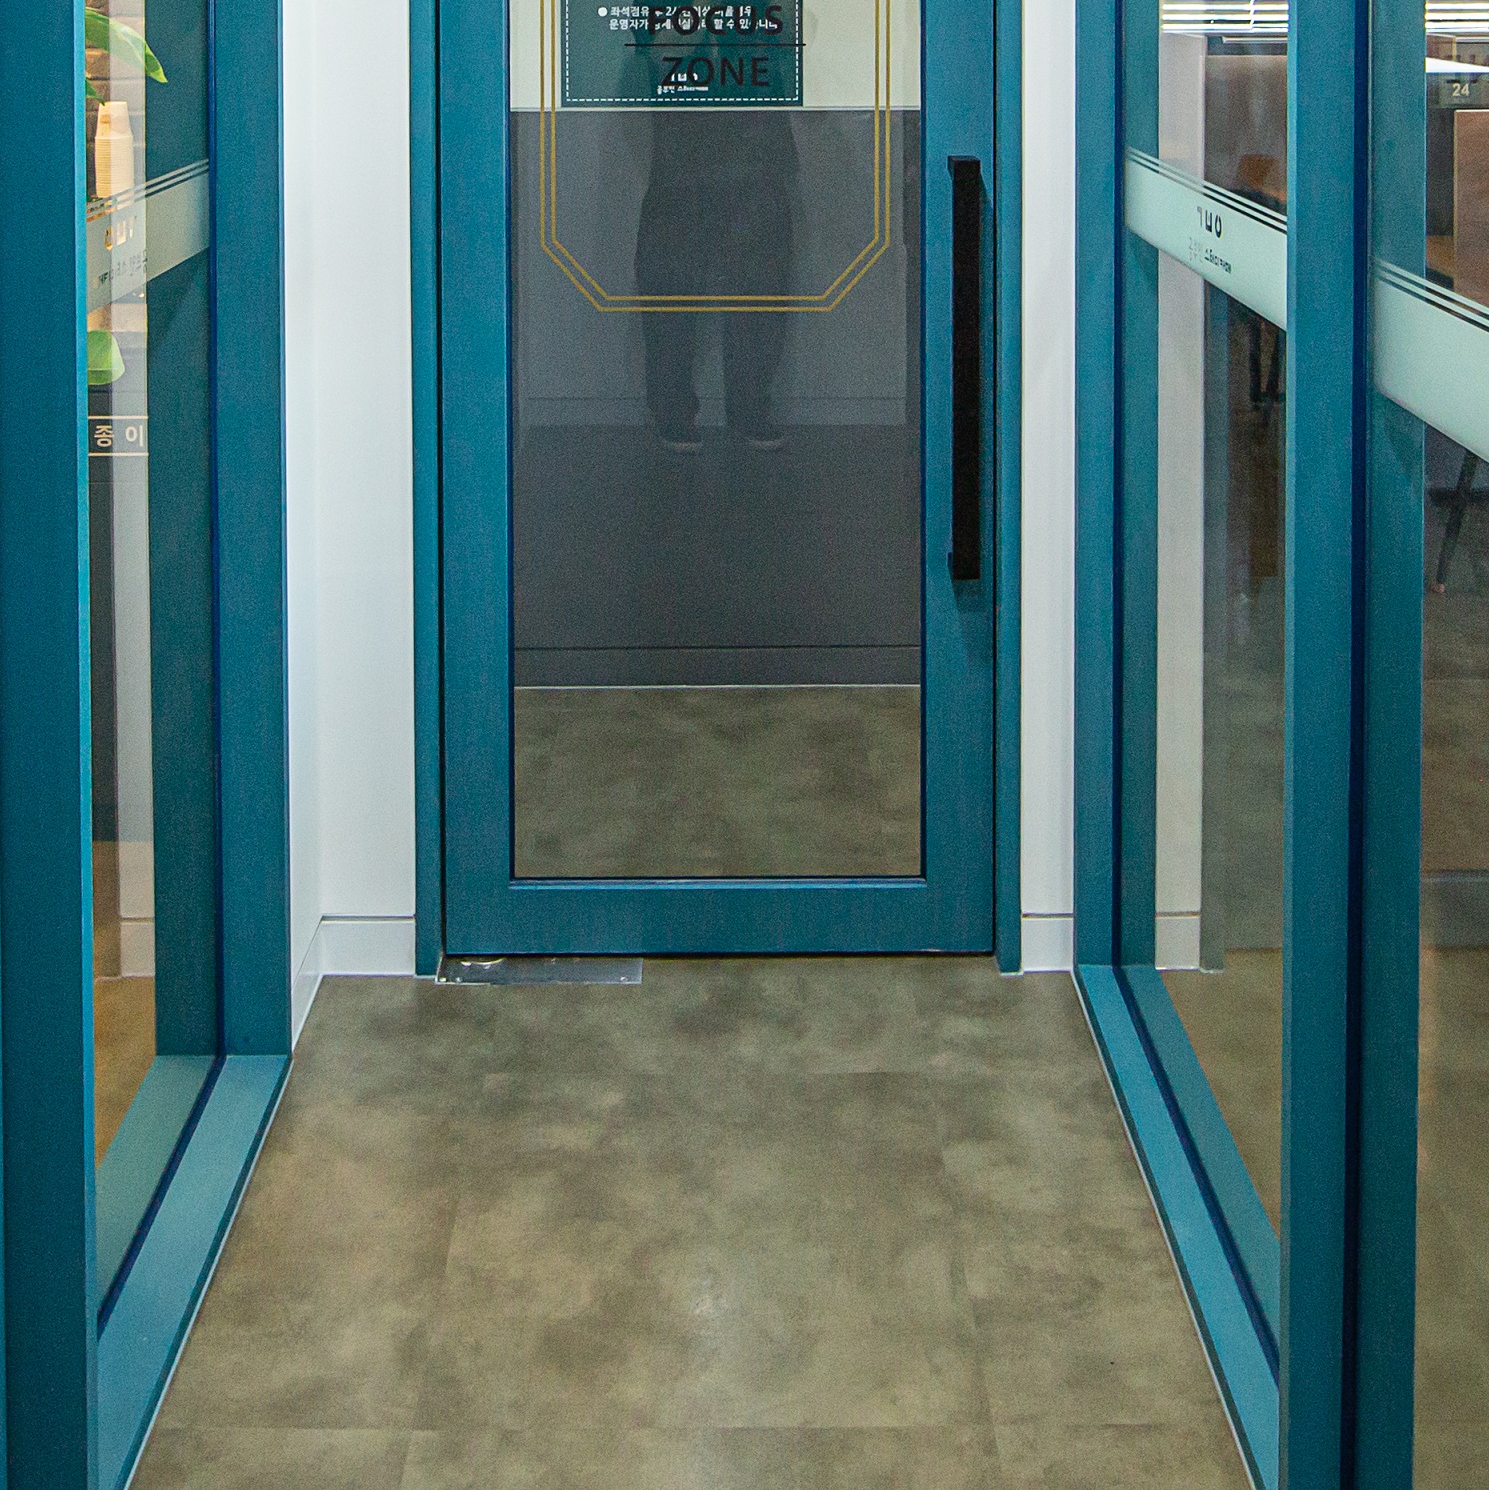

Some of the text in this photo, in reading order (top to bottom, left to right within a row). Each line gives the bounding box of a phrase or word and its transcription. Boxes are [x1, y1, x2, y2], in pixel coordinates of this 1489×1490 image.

[609, 18, 649, 30] 운영자가
[648, 4, 784, 37] FOCUS
[661, 56, 770, 87] ZONE
[1452, 83, 1469, 97] 24
